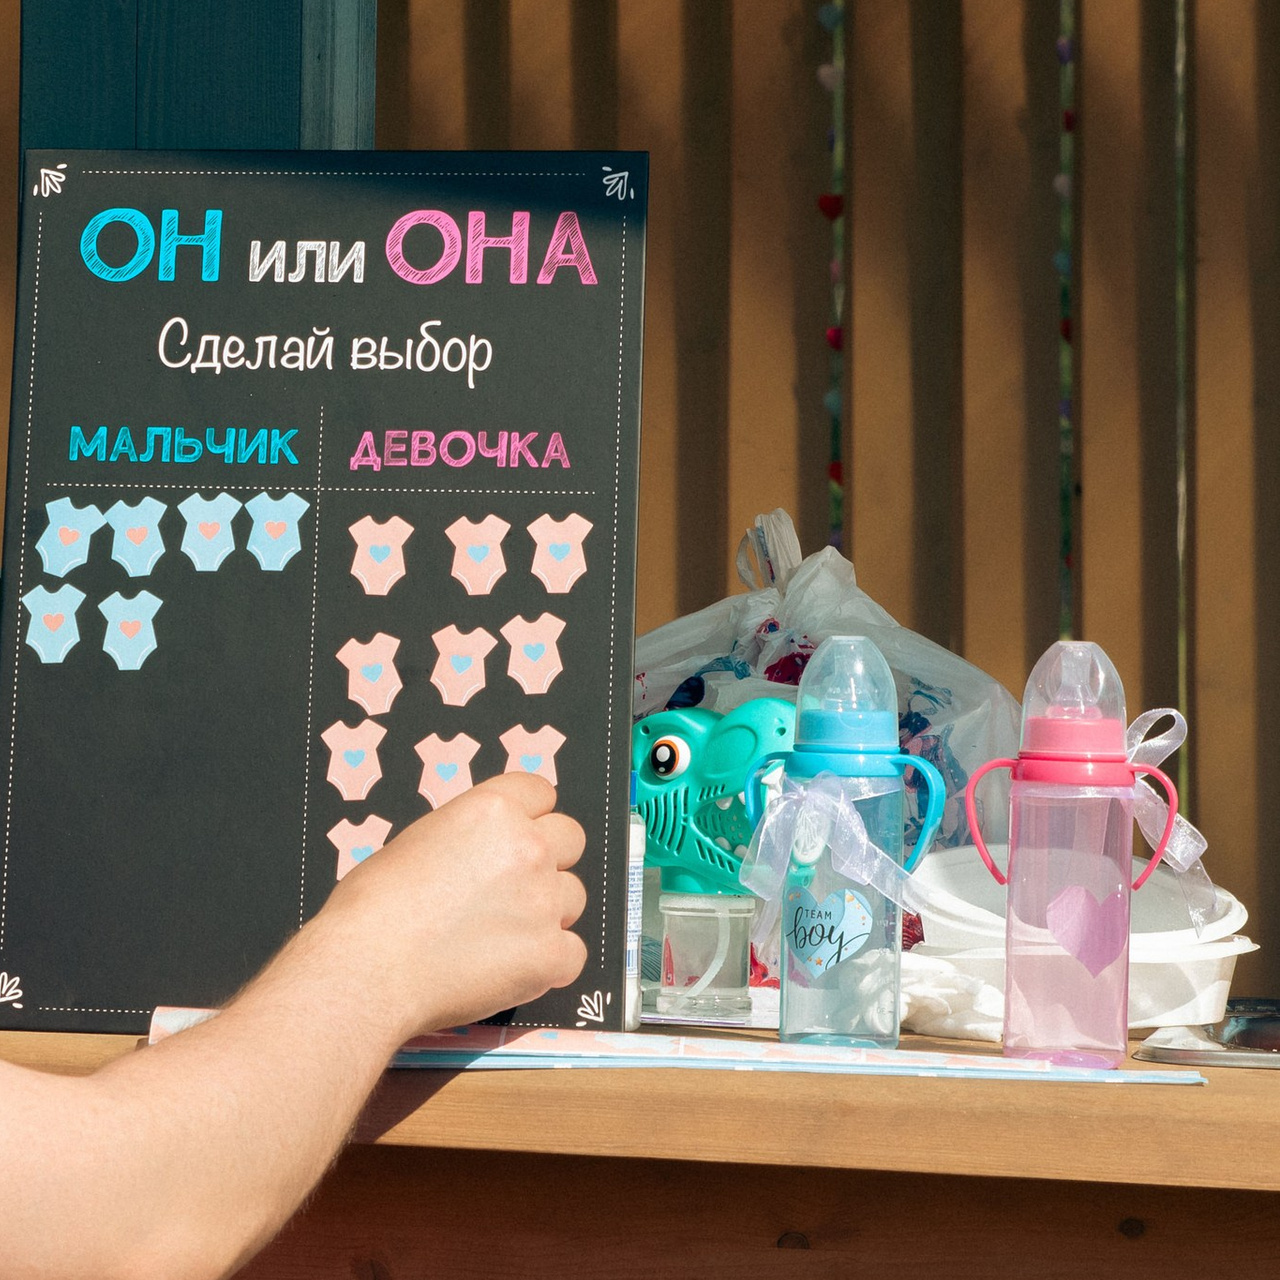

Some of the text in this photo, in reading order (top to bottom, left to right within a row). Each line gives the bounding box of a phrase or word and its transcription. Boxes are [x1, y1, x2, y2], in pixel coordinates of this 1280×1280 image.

[79, 207, 598, 286] ОН или ОНА
[158, 316, 493, 389] Сделай выбор
[68, 425, 300, 465] МАЛЬЧИК
[349, 429, 572, 472] ДЕВОЧКА
[786, 906, 871, 970] boy
[804, 909, 832, 920] TEAM
